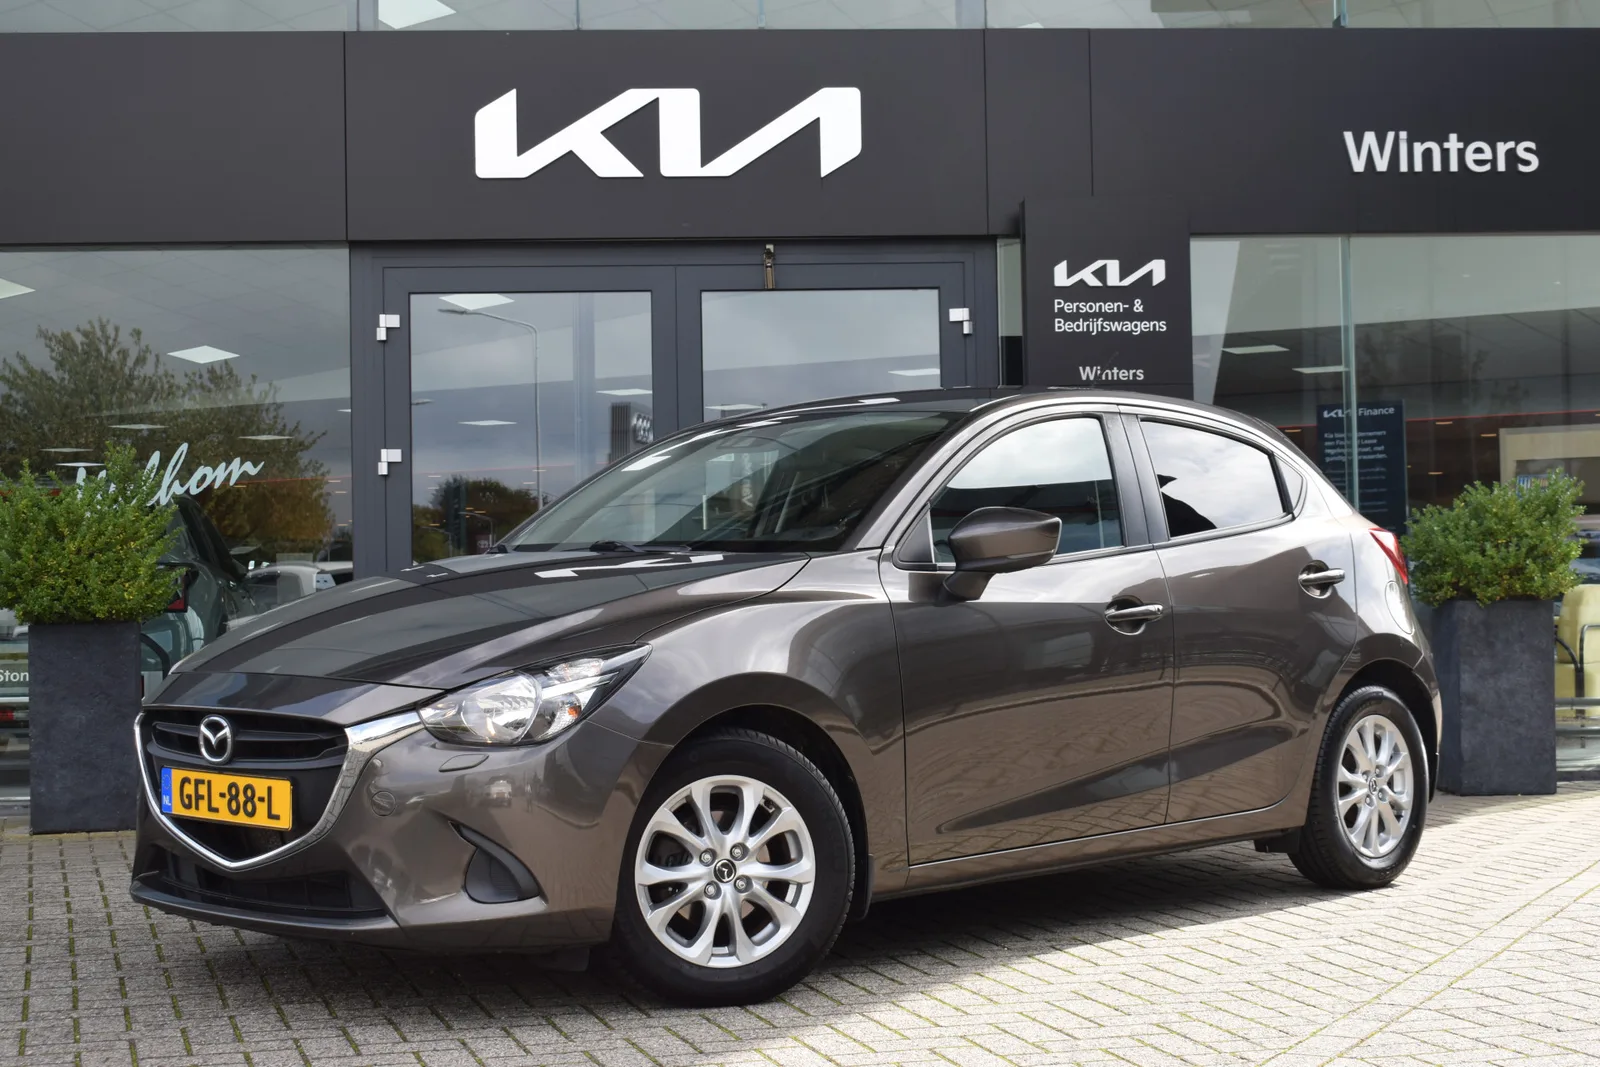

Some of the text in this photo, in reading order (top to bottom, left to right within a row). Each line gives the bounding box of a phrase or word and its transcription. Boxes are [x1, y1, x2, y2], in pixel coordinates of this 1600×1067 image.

[474, 87, 862, 178] KIA
[1343, 131, 1539, 173] Winters
[1053, 259, 1166, 287] KIA
[1054, 299, 1144, 313] Personen- &
[1054, 318, 1167, 335] Bedrijfswagens
[1078, 366, 1144, 381] Winters
[1358, 407, 1395, 417] Finance
[163, 776, 281, 821] NL GFL-88-L
